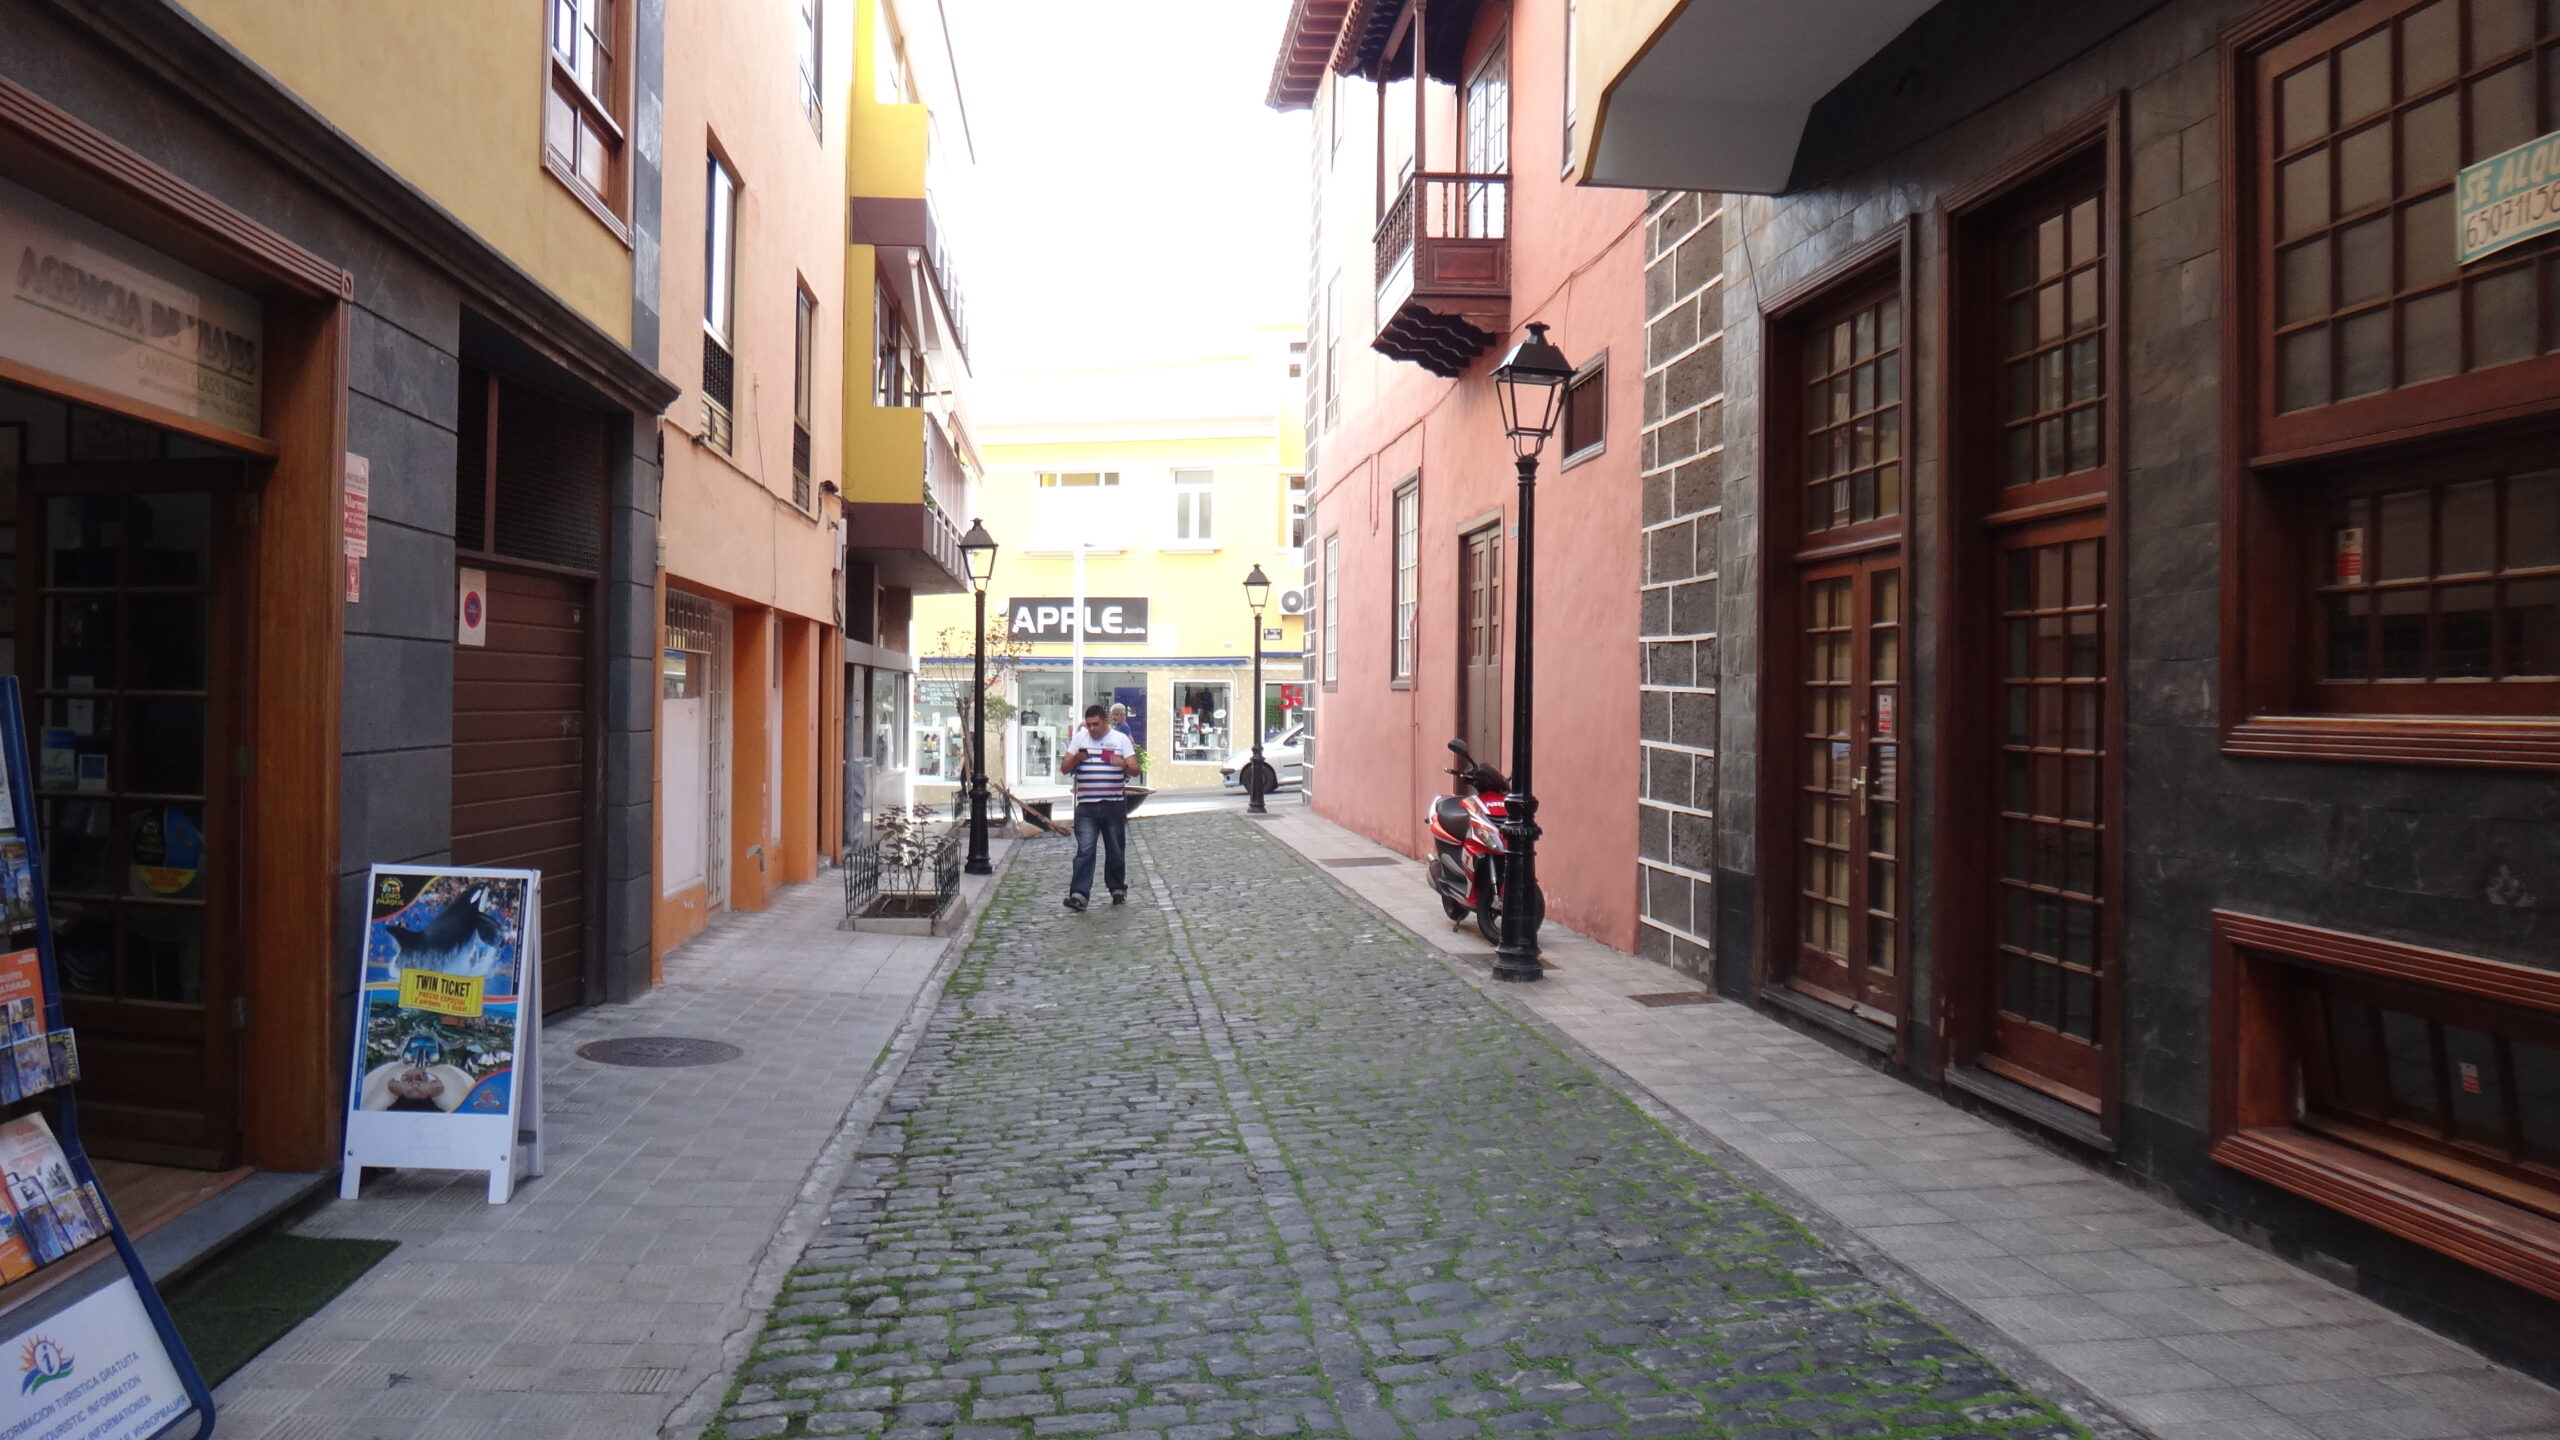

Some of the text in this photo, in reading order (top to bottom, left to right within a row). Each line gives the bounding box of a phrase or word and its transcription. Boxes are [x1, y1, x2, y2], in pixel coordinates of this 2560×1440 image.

[2463, 167, 2493, 210] SE
[16, 246, 146, 335] AGENCIA
[1011, 606, 1122, 634] APPLE
[416, 975, 471, 998] TWIN TICKET
[0, 1351, 140, 1440] FORMACION TURISTICA GRATUITA
[87, 1375, 143, 1417] INFORMATION
